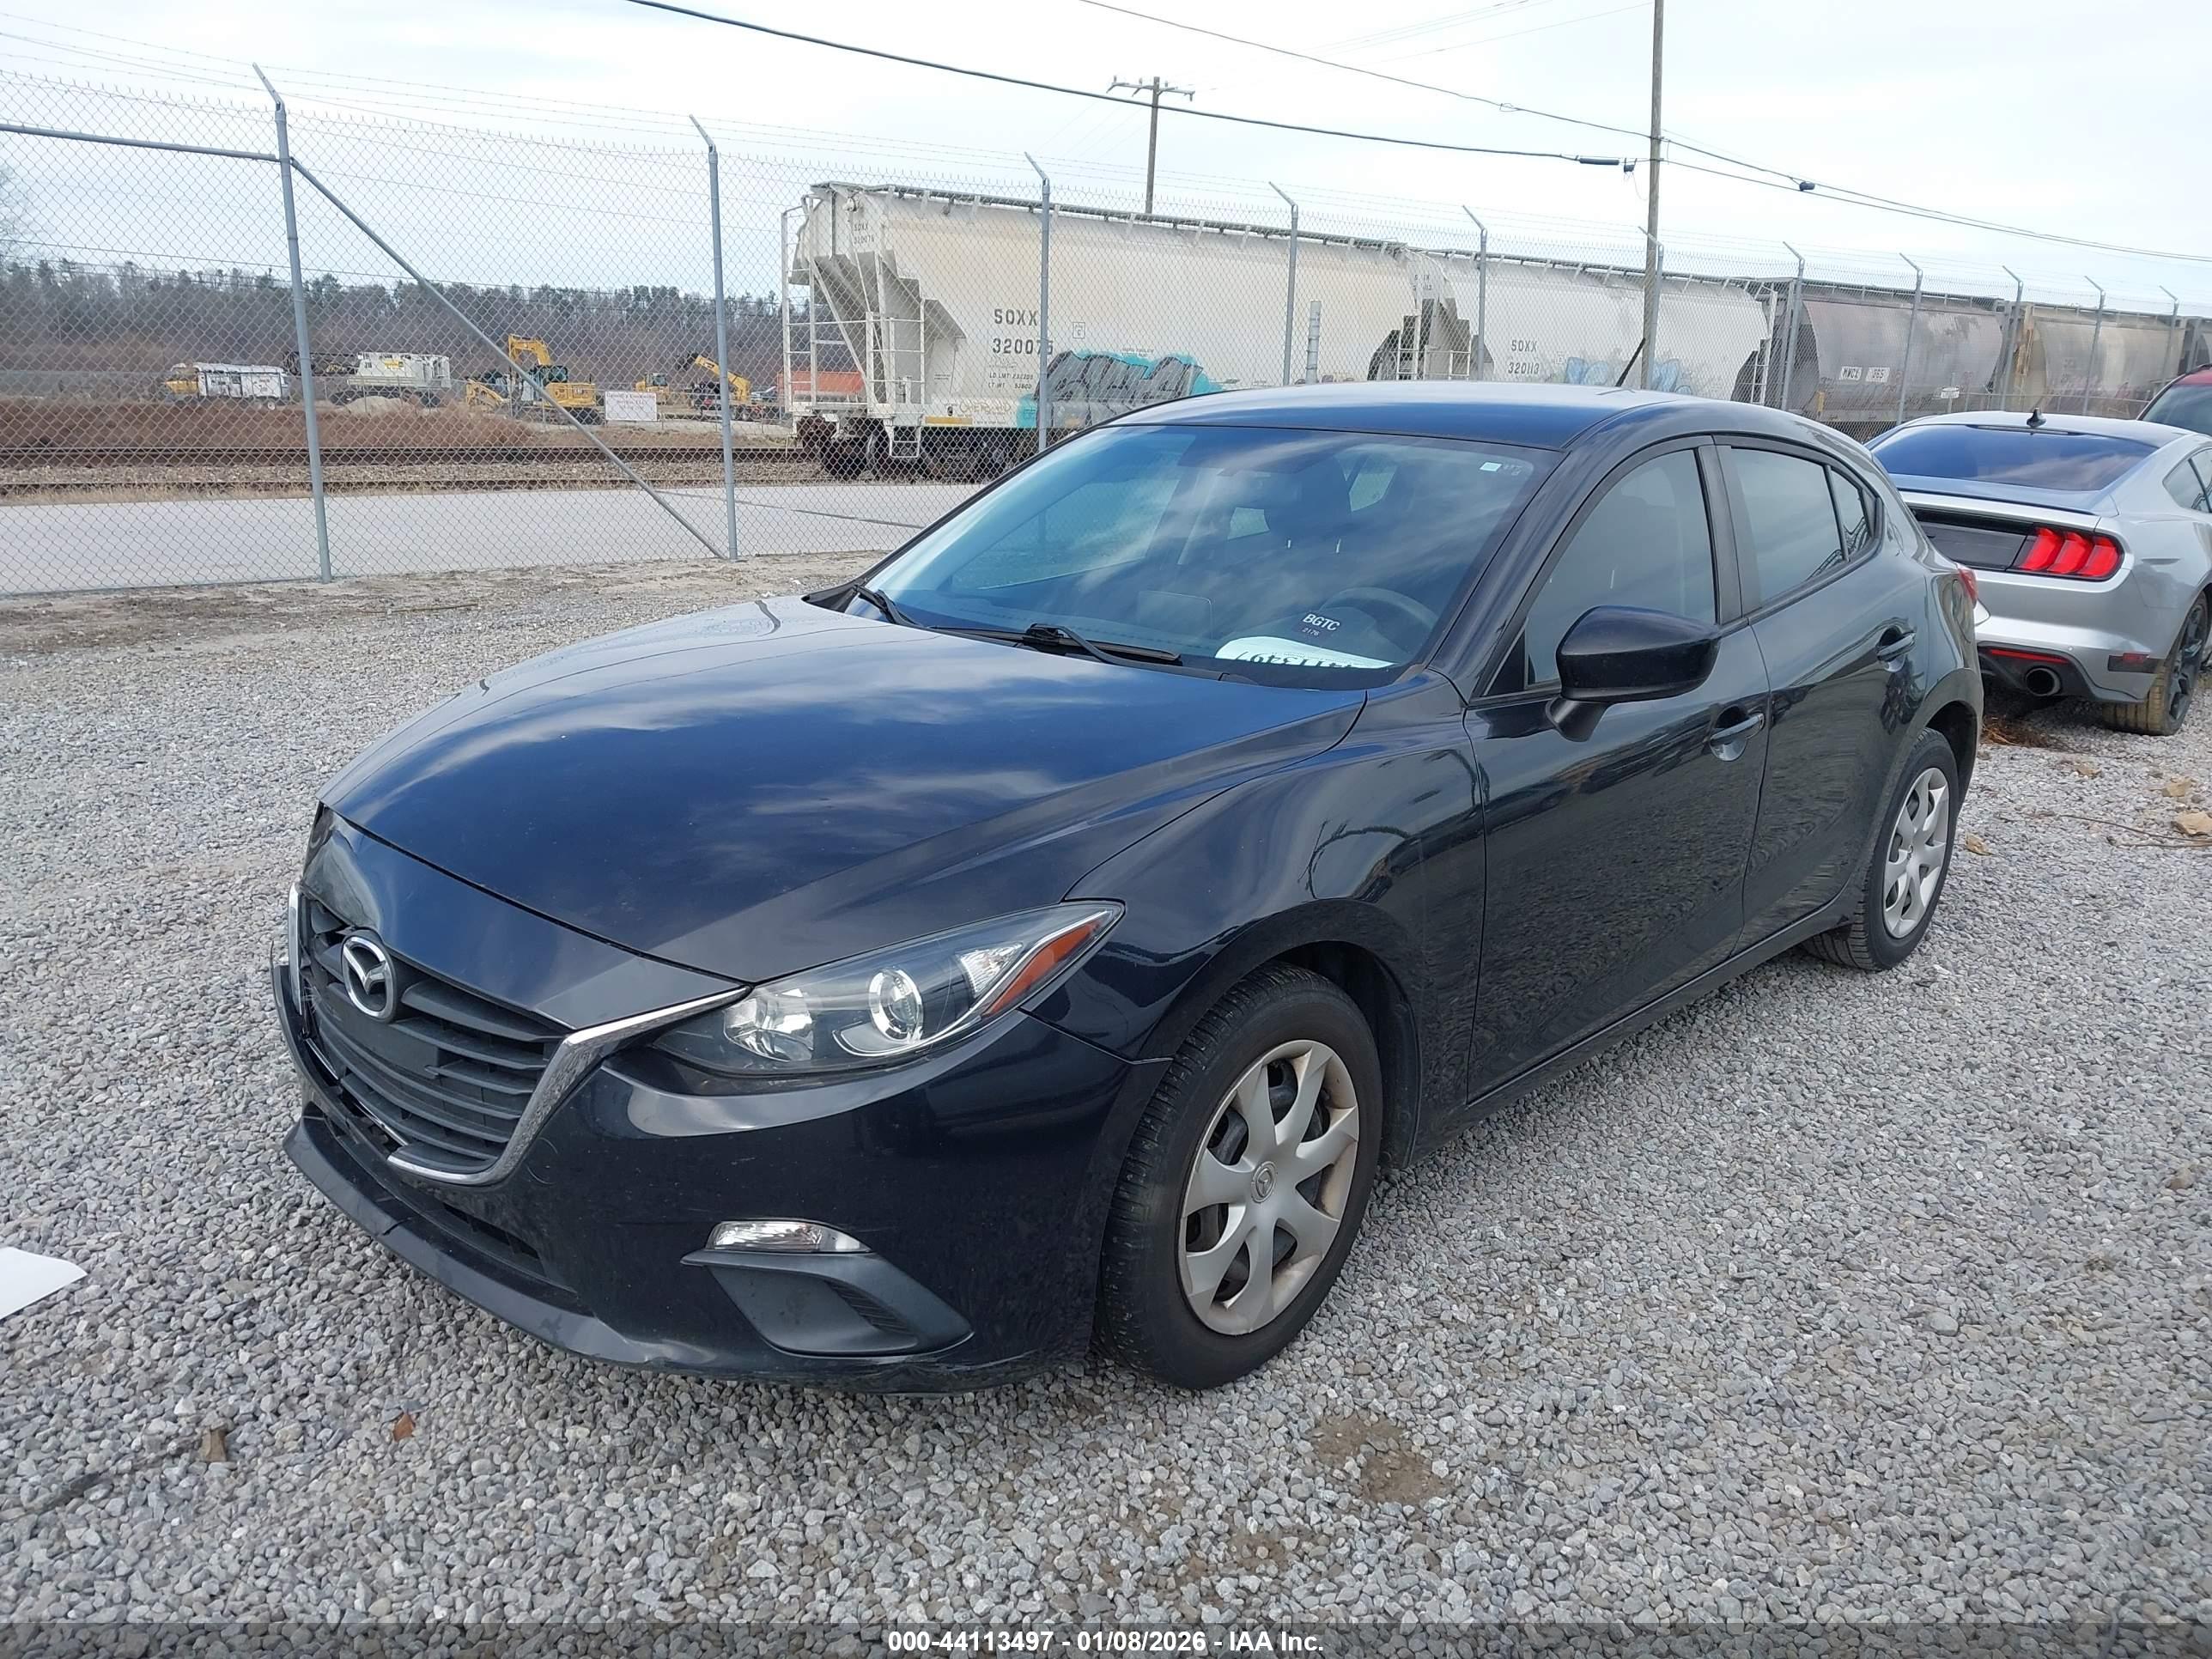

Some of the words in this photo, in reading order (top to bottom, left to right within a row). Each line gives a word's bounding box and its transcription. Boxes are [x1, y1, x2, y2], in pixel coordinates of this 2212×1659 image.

[994, 308, 1038, 326] SOXX
[1510, 339, 1538, 353] SOXX
[1507, 362, 1540, 374] 320113
[1303, 613, 1340, 631] BGTC
